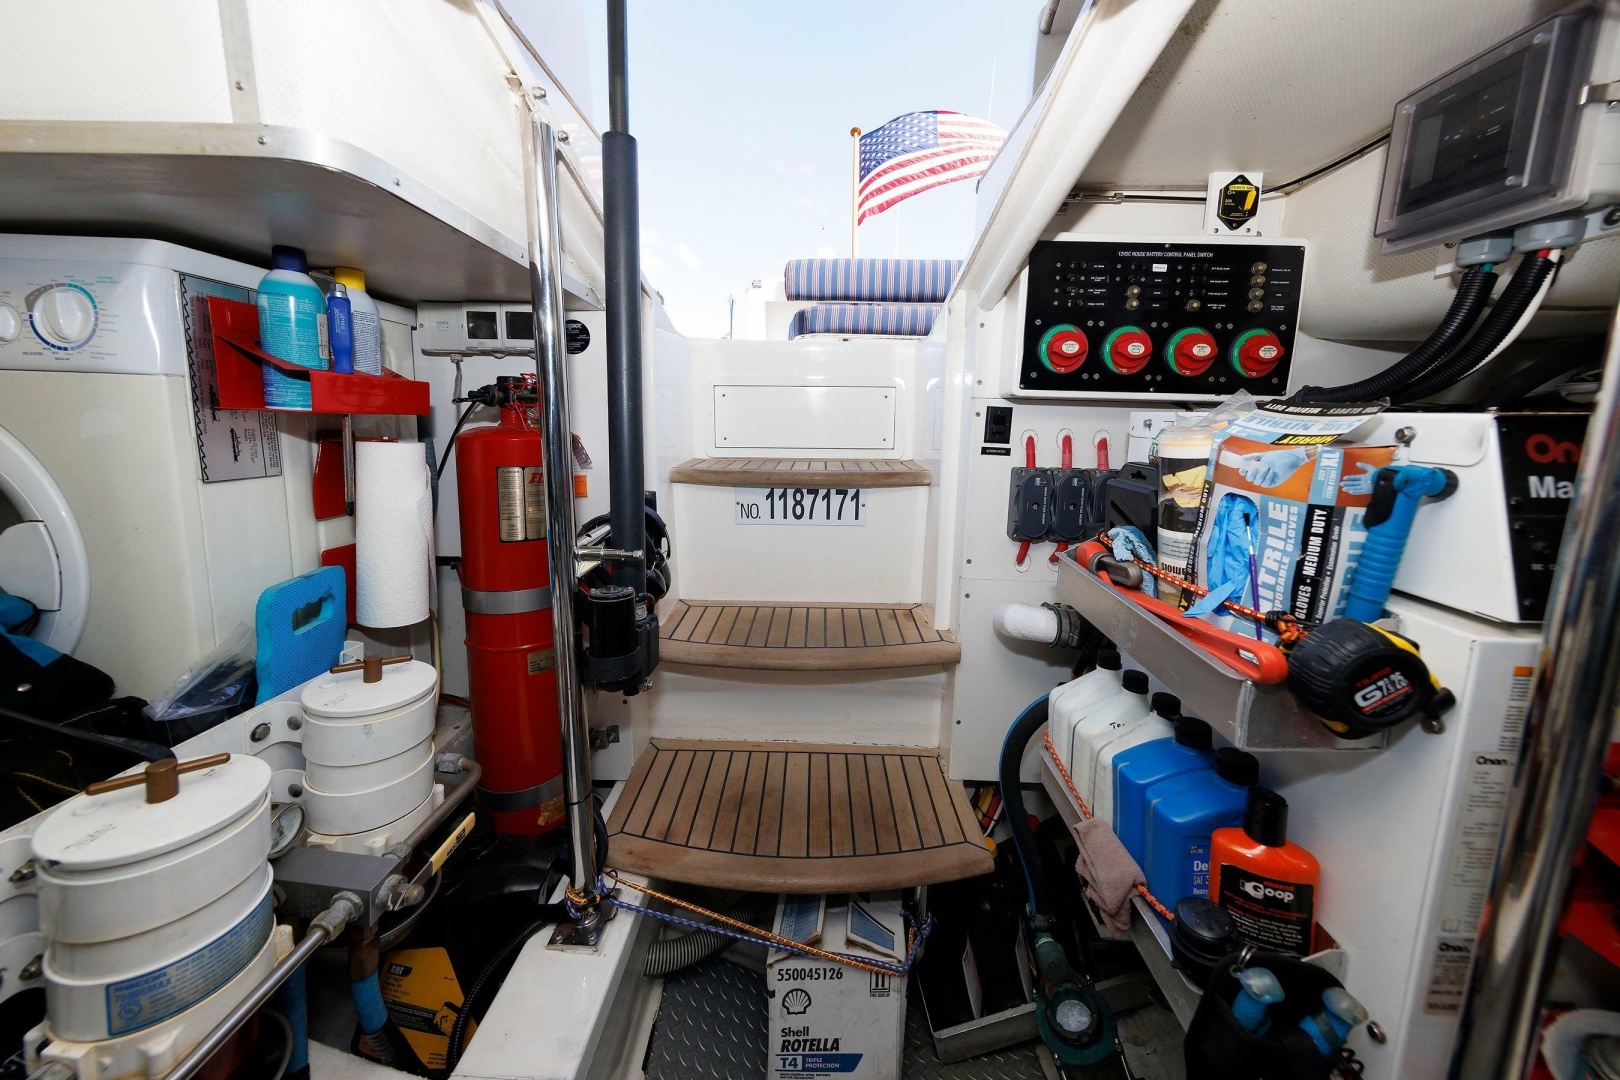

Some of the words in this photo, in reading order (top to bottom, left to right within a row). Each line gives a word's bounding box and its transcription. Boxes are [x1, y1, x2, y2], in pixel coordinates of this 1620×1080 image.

[1242, 414, 1316, 432] NITRILE
[1277, 435, 1338, 445] HARDY
[1526, 434, 1583, 464] On
[1320, 452, 1340, 467] XL
[1528, 476, 1574, 498] Ma
[740, 503, 761, 519] NO.
[766, 487, 860, 520] 1187171
[1194, 506, 1204, 538] MEDIUM
[1202, 484, 1210, 504] DUTY
[1311, 509, 1327, 534] DUTY
[1274, 556, 1290, 612] SPOSABLE
[1286, 506, 1298, 552] GLOVES
[1302, 536, 1322, 576] MEDIUM
[1320, 576, 1331, 602] Protection
[1326, 542, 1338, 570] Examination
[1332, 525, 1340, 540] Grade
[1161, 562, 1187, 575] amois
[1295, 585, 1312, 620] GLOVES
[1476, 756, 1508, 766] Onan
[1194, 860, 1209, 872] De
[1193, 876, 1203, 885] SAE
[1263, 881, 1294, 891] ORANGE
[1244, 881, 1294, 903] Goop
[391, 965, 404, 975] CAT
[777, 968, 843, 981] 550045126
[781, 1026, 809, 1037] Shell
[780, 1038, 840, 1052] ROTELLA
[780, 1058, 798, 1068] T4
